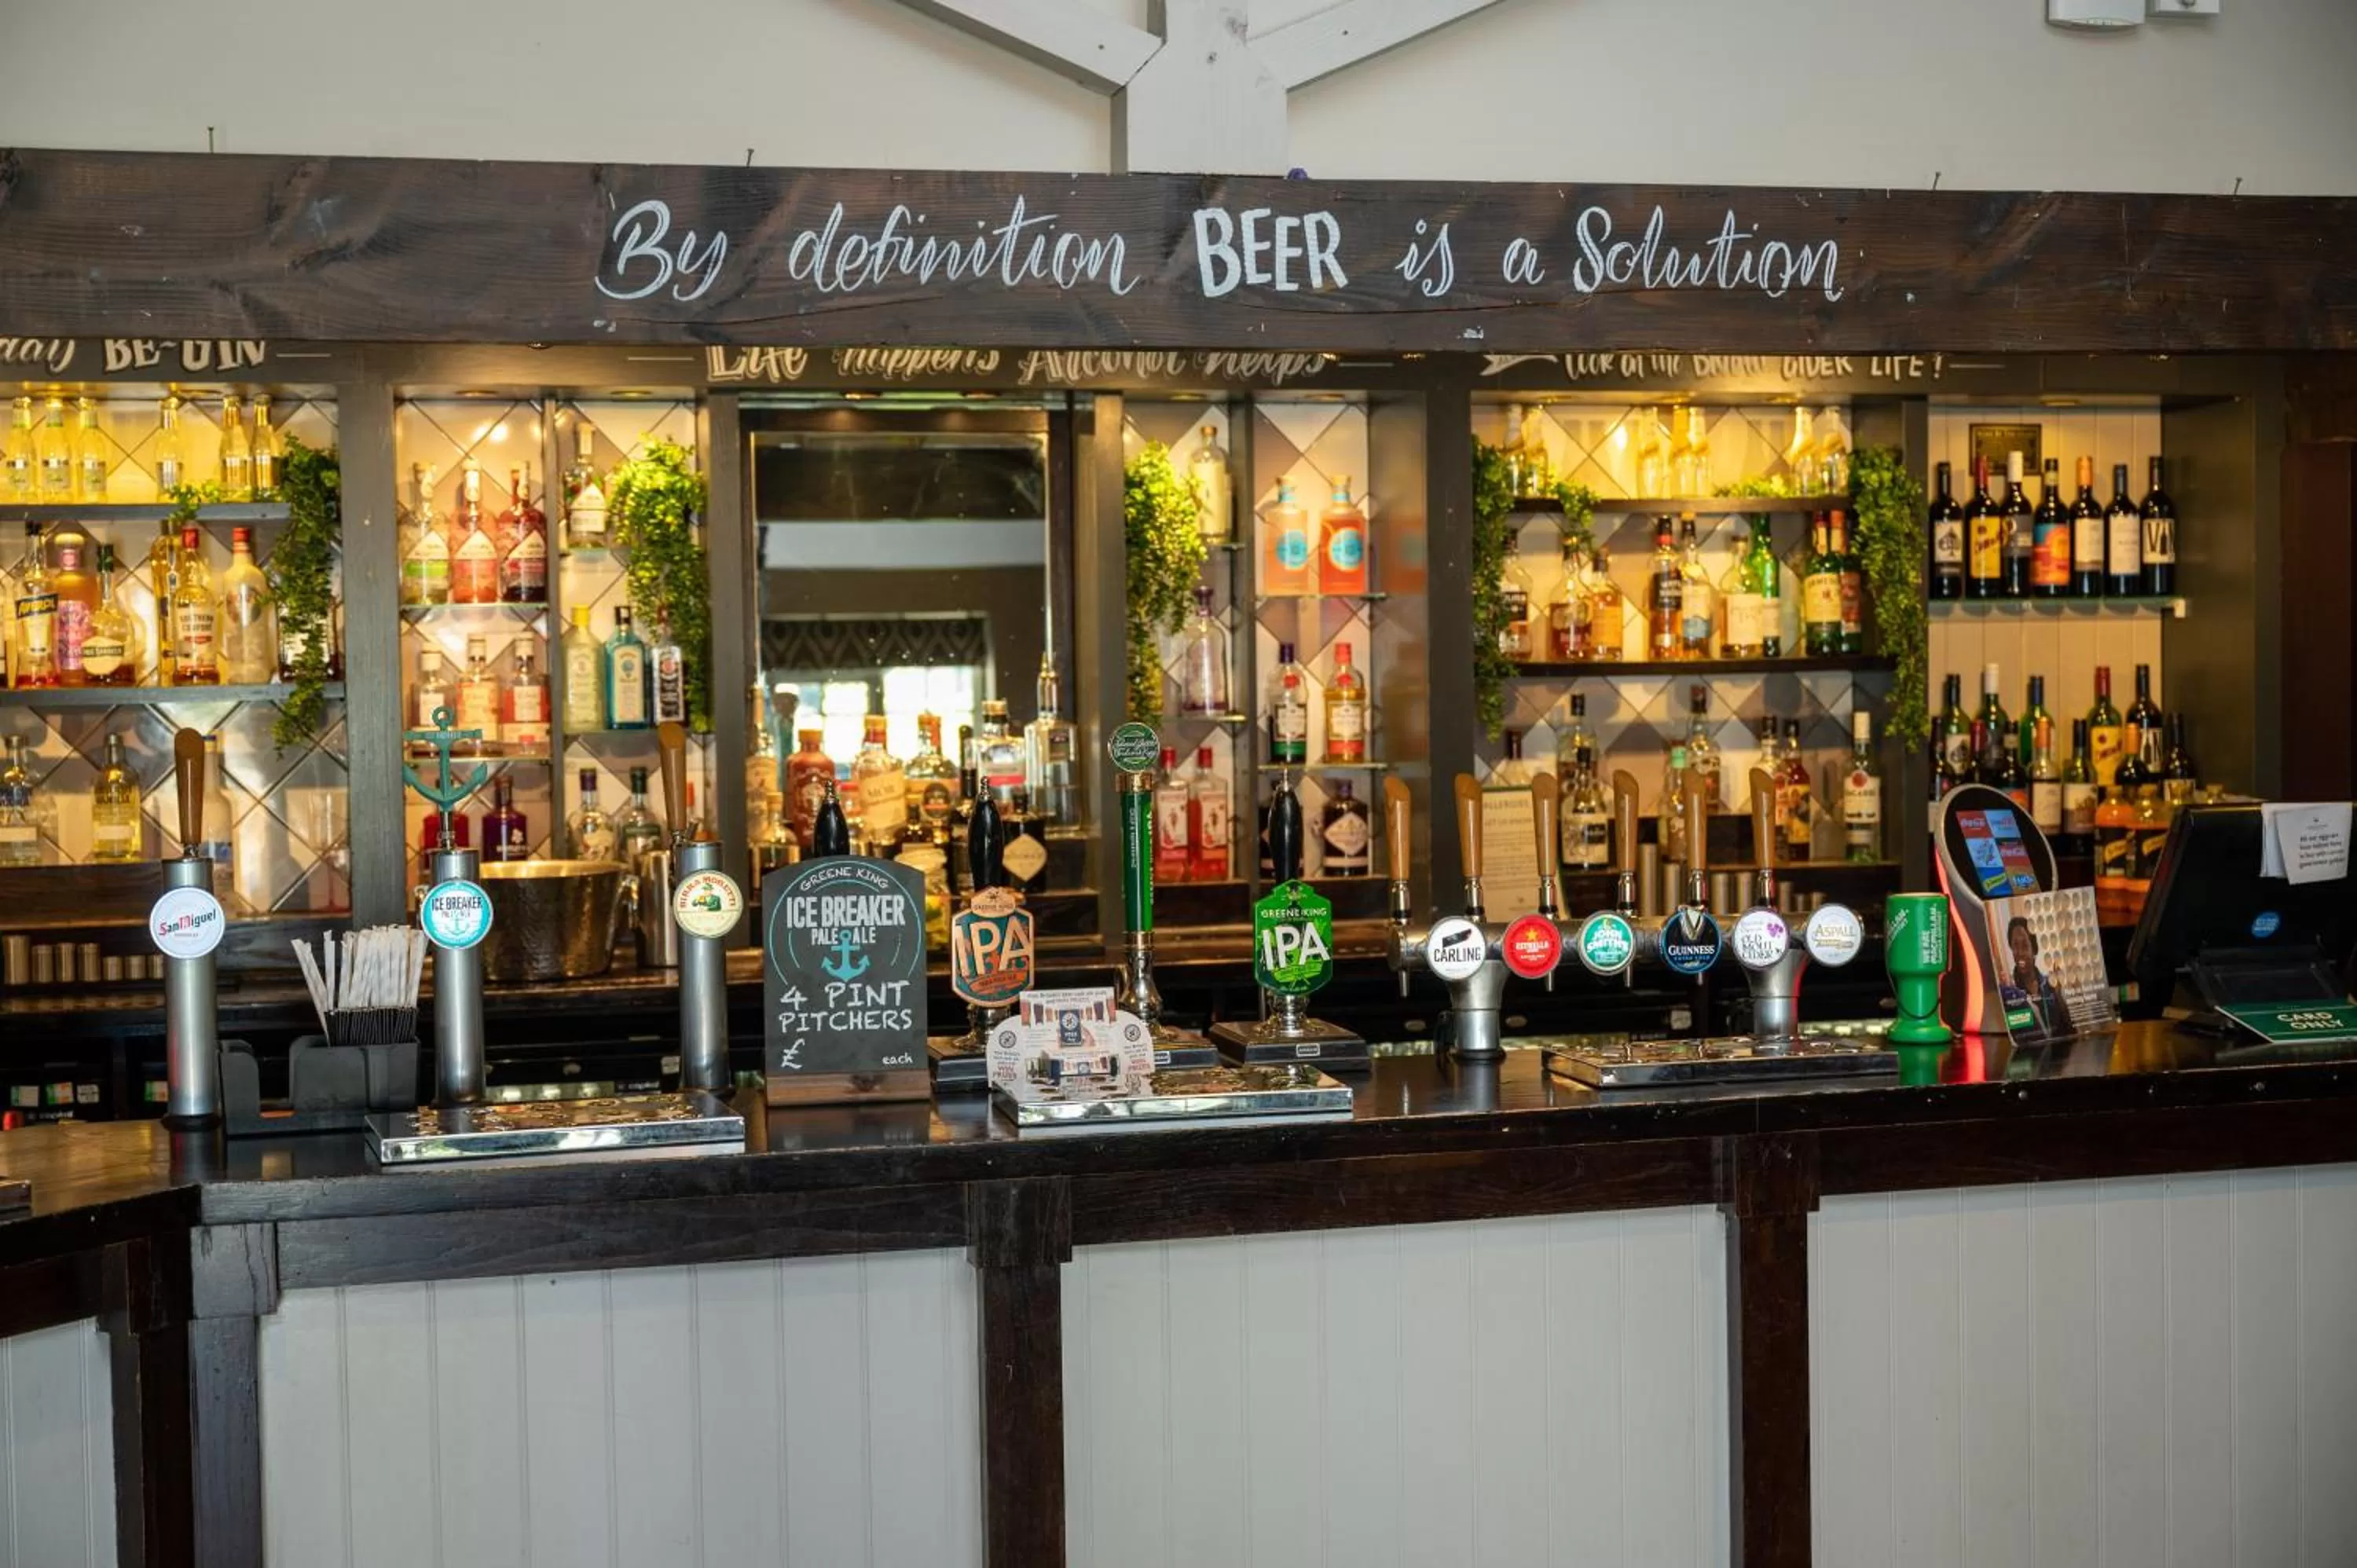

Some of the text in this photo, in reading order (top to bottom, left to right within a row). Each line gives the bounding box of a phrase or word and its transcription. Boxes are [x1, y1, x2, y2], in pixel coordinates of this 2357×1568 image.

[595, 194, 1844, 302] By definition BEER is a Solution
[800, 866, 889, 892] GREENE KING
[431, 896, 483, 911] ICE BREAKER
[786, 895, 906, 929] ICE BREAKER
[1261, 907, 1327, 918] GREENE KING
[811, 927, 877, 946] PALE ALE
[1594, 929, 1622, 941] JOHN
[954, 916, 1032, 979] IPA
[1262, 921, 1331, 971] IPA
[1434, 947, 1481, 962] CARLING
[1668, 945, 1716, 956] GUINNESS
[780, 980, 911, 1011] 4 PINT
[779, 1009, 912, 1033] PITCHERS
[2277, 1011, 2333, 1022] CARD
[2290, 1019, 2344, 1030] ONLY
[780, 1038, 913, 1069] £ each
